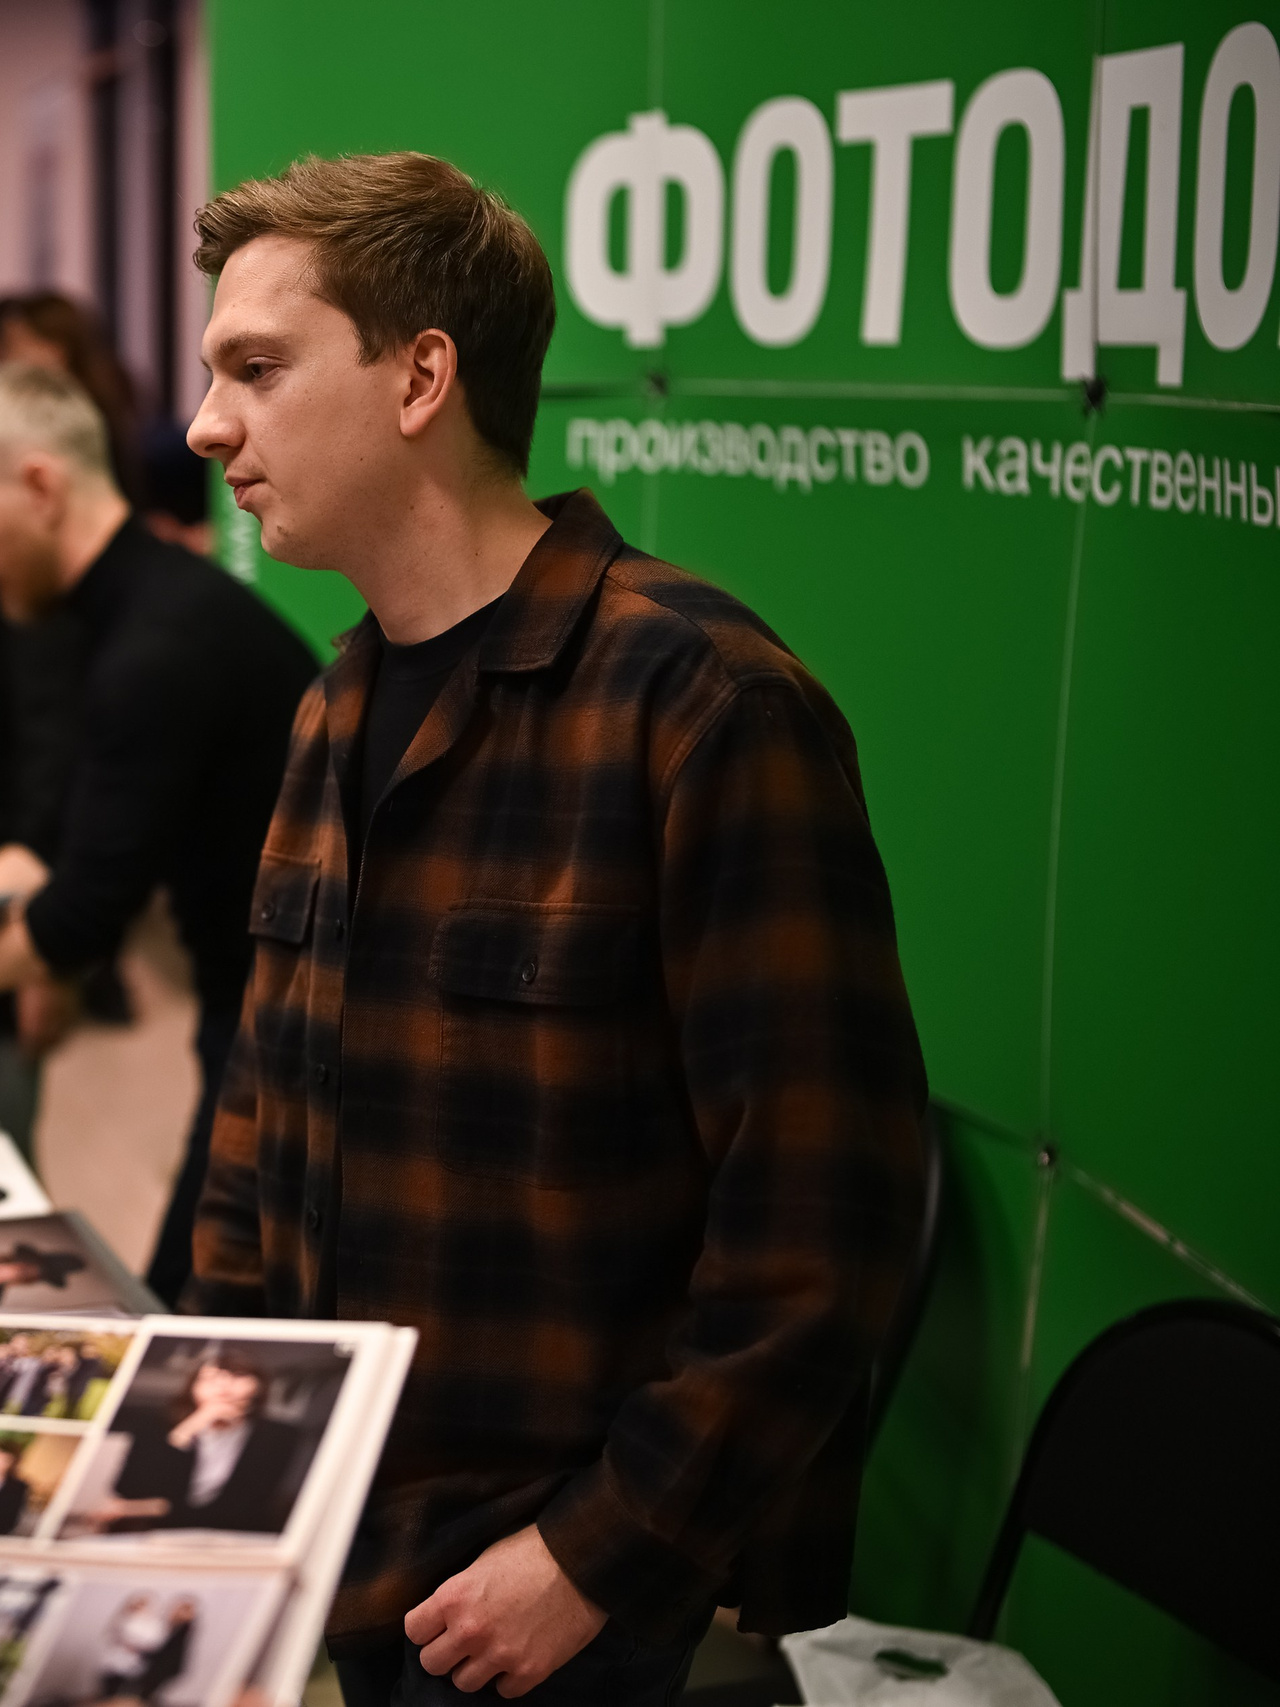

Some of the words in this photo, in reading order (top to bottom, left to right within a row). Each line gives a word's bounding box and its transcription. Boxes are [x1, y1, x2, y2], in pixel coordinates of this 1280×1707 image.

[565, 21, 1280, 387] ФОТОДО
[566, 417, 930, 493] производство
[961, 435, 1280, 529] качественны
